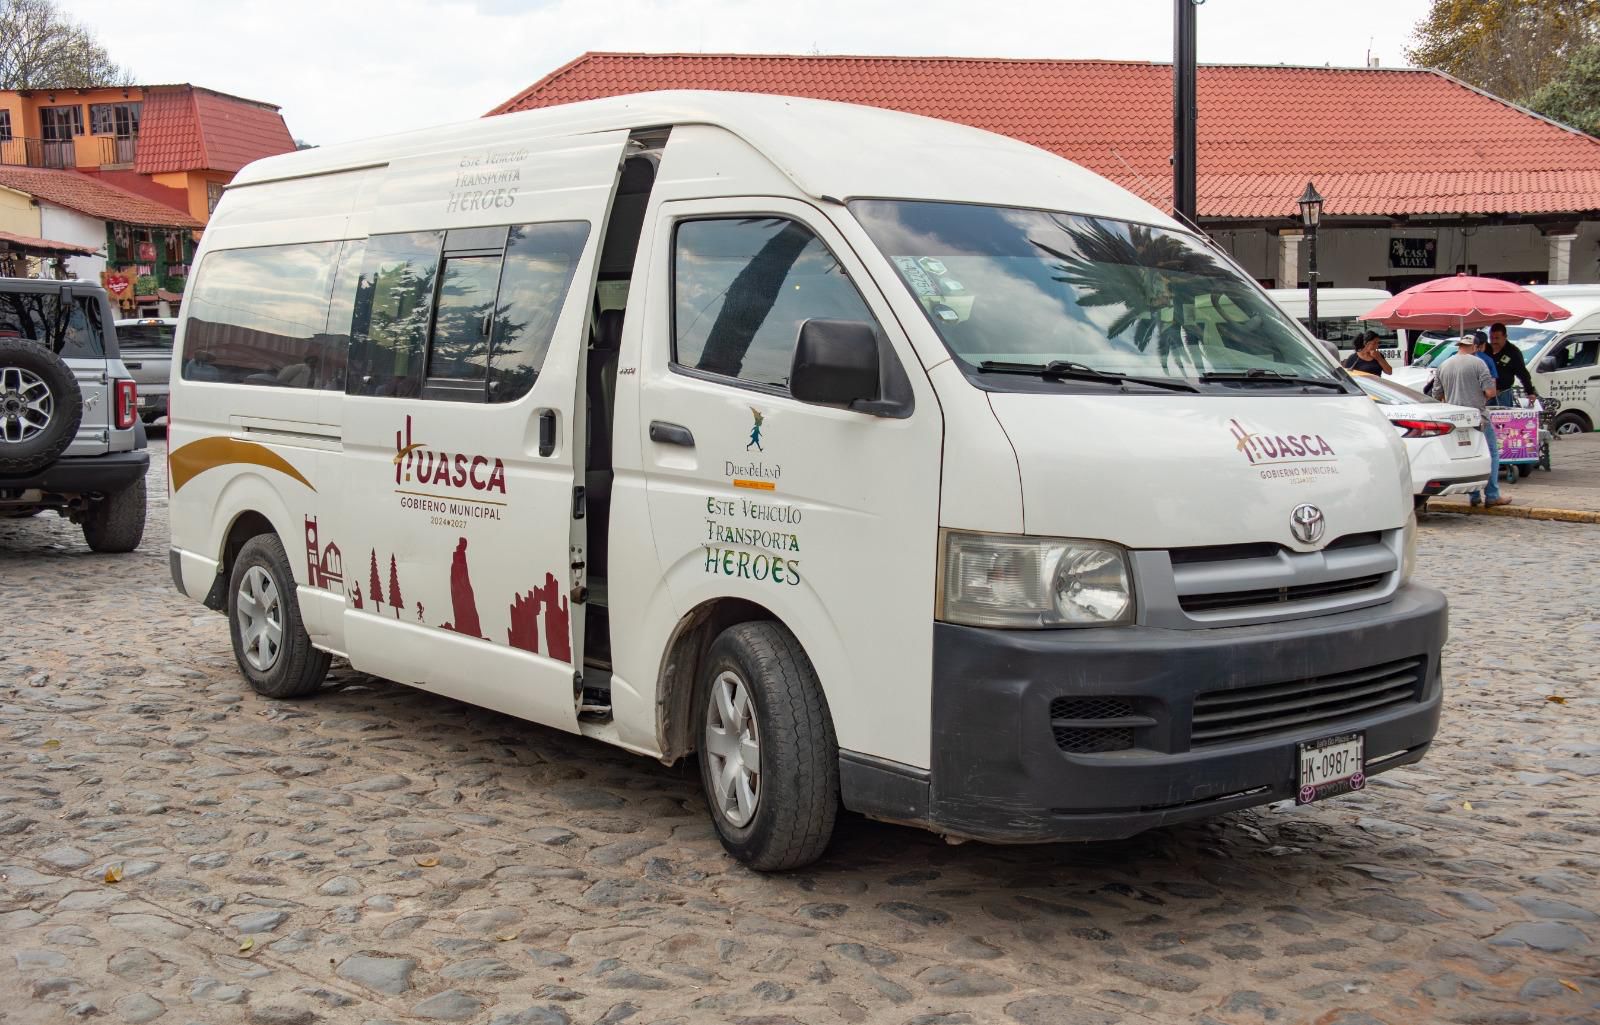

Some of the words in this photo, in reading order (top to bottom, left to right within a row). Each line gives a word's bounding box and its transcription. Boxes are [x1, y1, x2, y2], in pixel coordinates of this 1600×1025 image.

[1400, 258, 1428, 267] MAYA
[1404, 249, 1428, 258] CASA
[1230, 418, 1336, 464] HUASCA
[393, 413, 507, 495] HUASCA
[1260, 468, 1300, 480] GOBIERNO
[1301, 465, 1340, 476] MUNICIPAL
[400, 496, 447, 514] GOBIERNO
[449, 503, 501, 521] MUNICIPAL
[704, 545, 801, 586] HEROES
